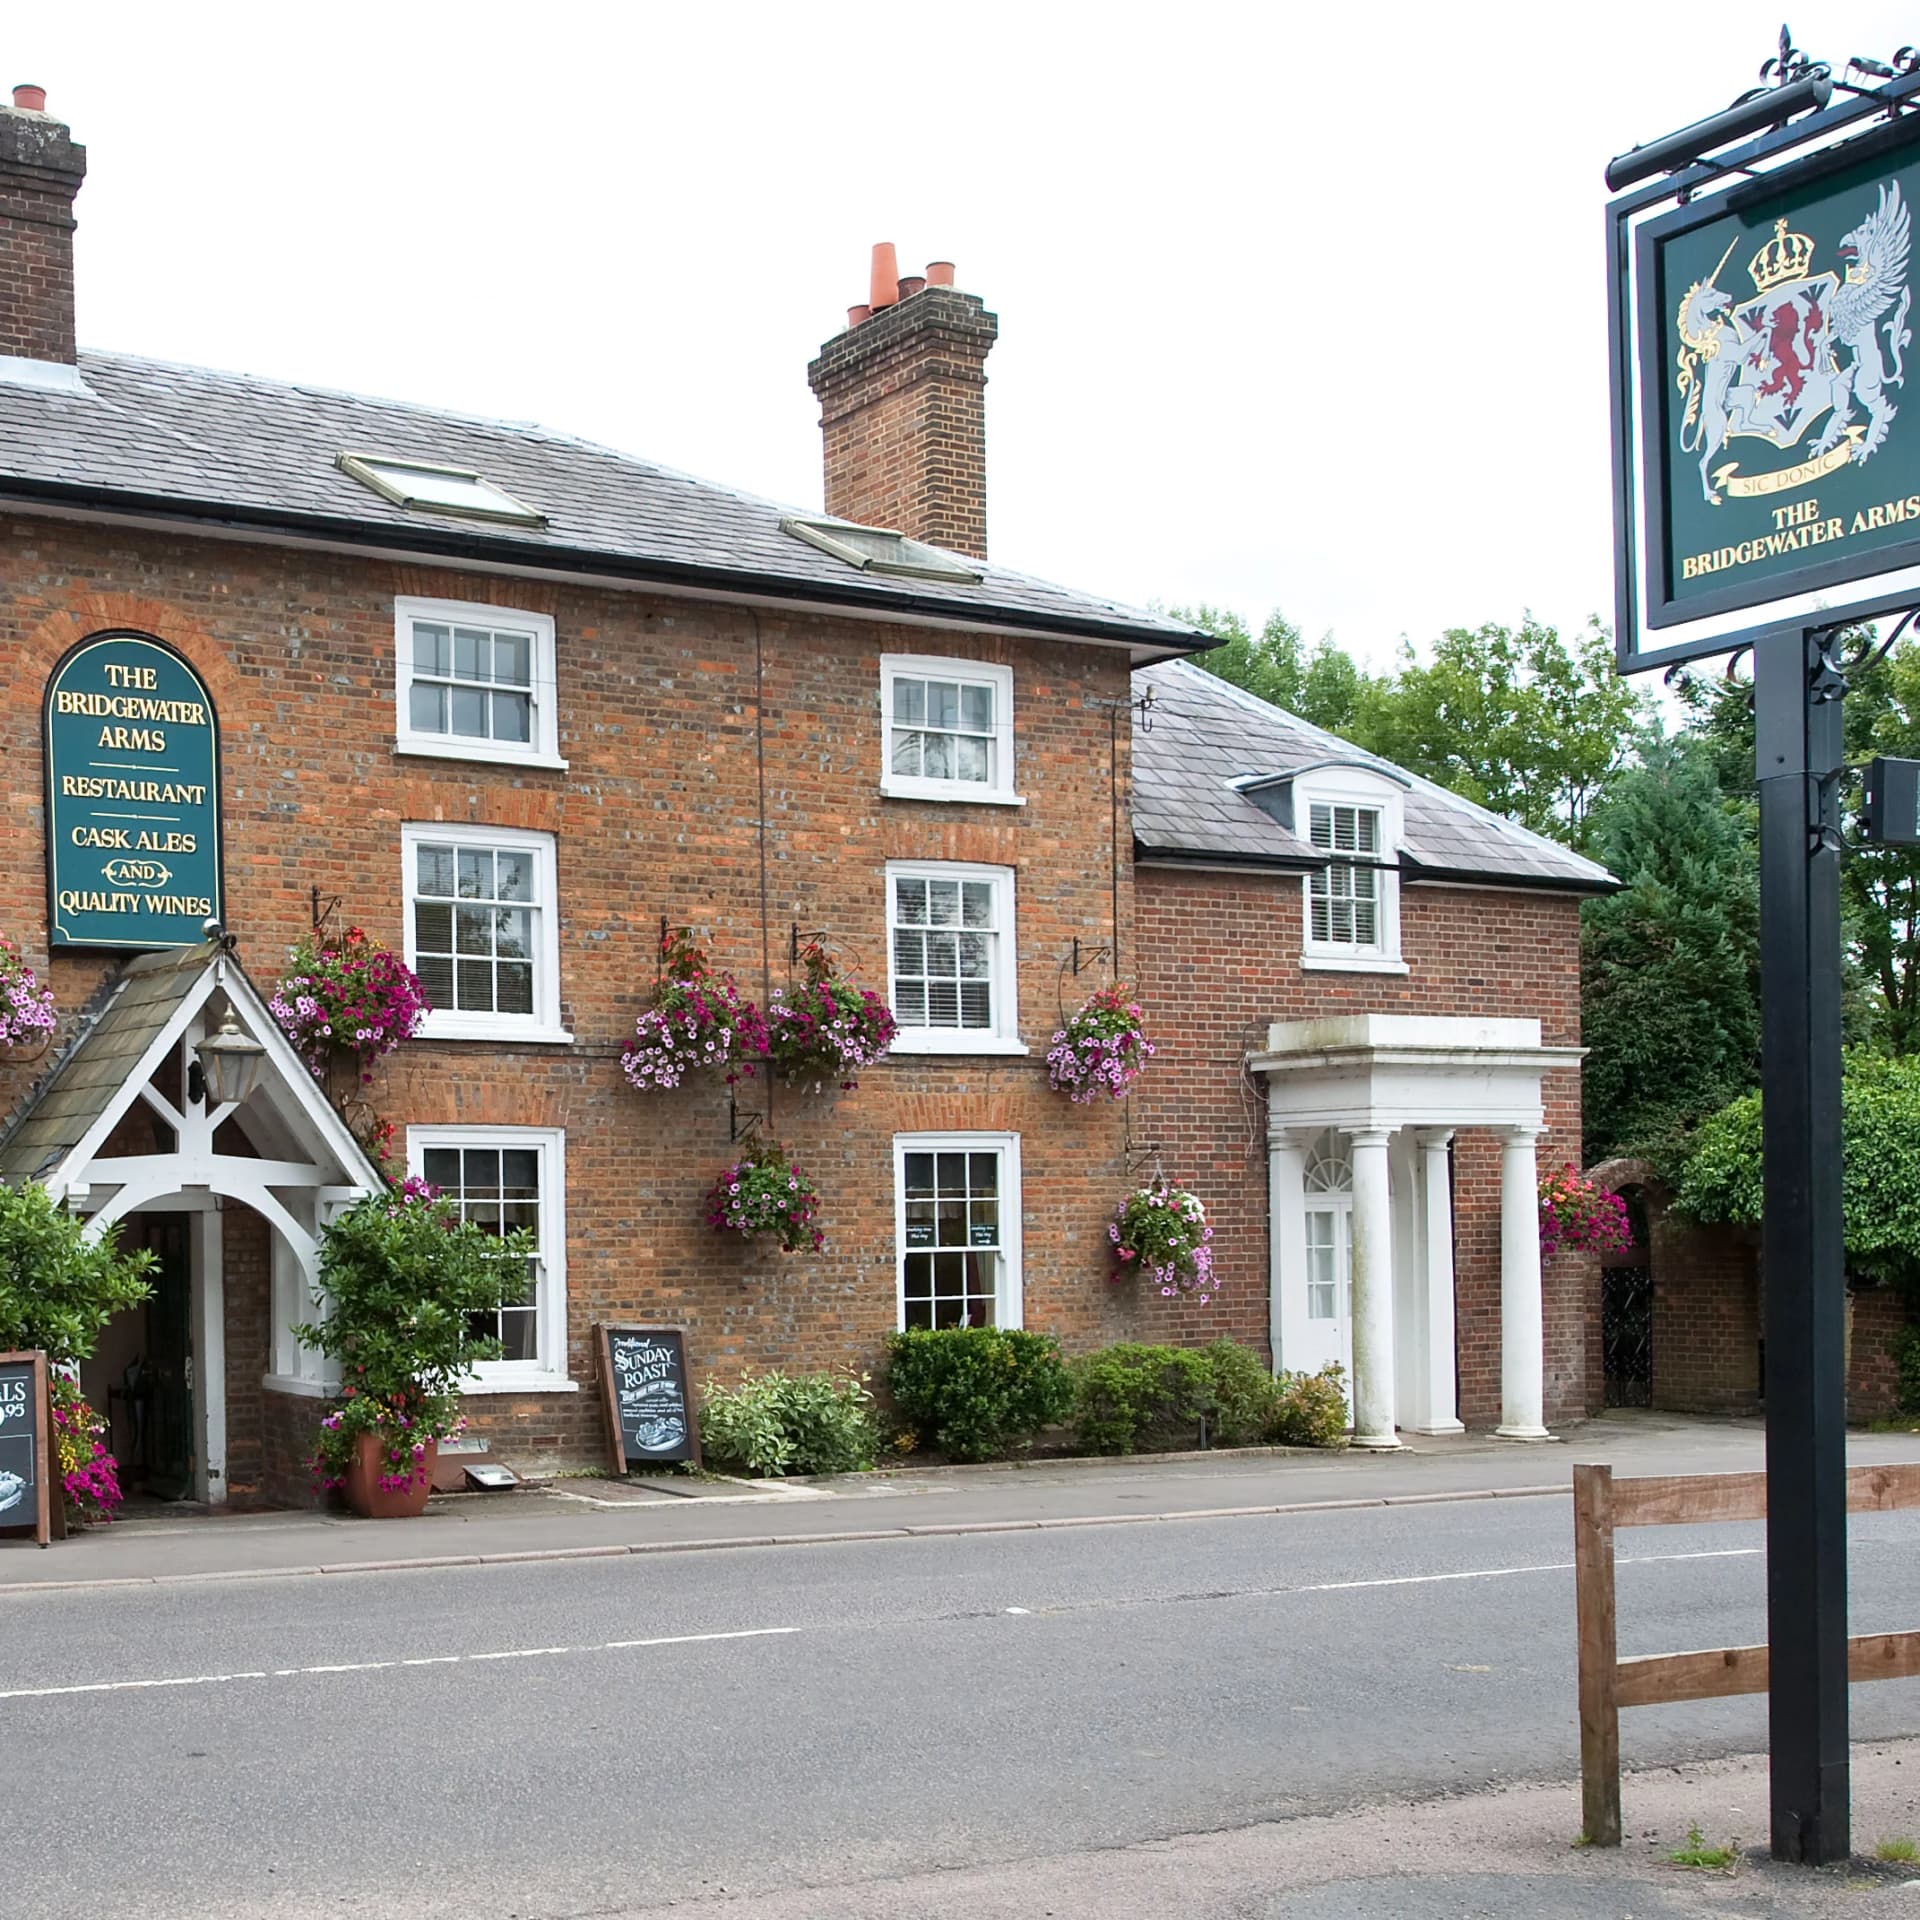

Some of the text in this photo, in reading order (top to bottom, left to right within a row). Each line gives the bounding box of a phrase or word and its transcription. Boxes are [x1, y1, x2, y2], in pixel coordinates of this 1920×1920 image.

[1744, 476, 1770, 494] SIC
[1772, 499, 1820, 530] THE
[1682, 495, 1920, 580] BRIDGEWATER ARMS
[104, 664, 157, 691] THE
[57, 691, 206, 725] BRIDGEWATER
[98, 727, 166, 752] ARMS
[62, 775, 206, 805] RESTAURANT
[71, 827, 197, 854] CASK ALES
[118, 864, 155, 880] AND
[59, 890, 211, 917] QUALITY WINES
[614, 1348, 677, 1375] SUNDAY
[624, 1363, 670, 1389] ROAST
[0, 1382, 26, 1402] LS
